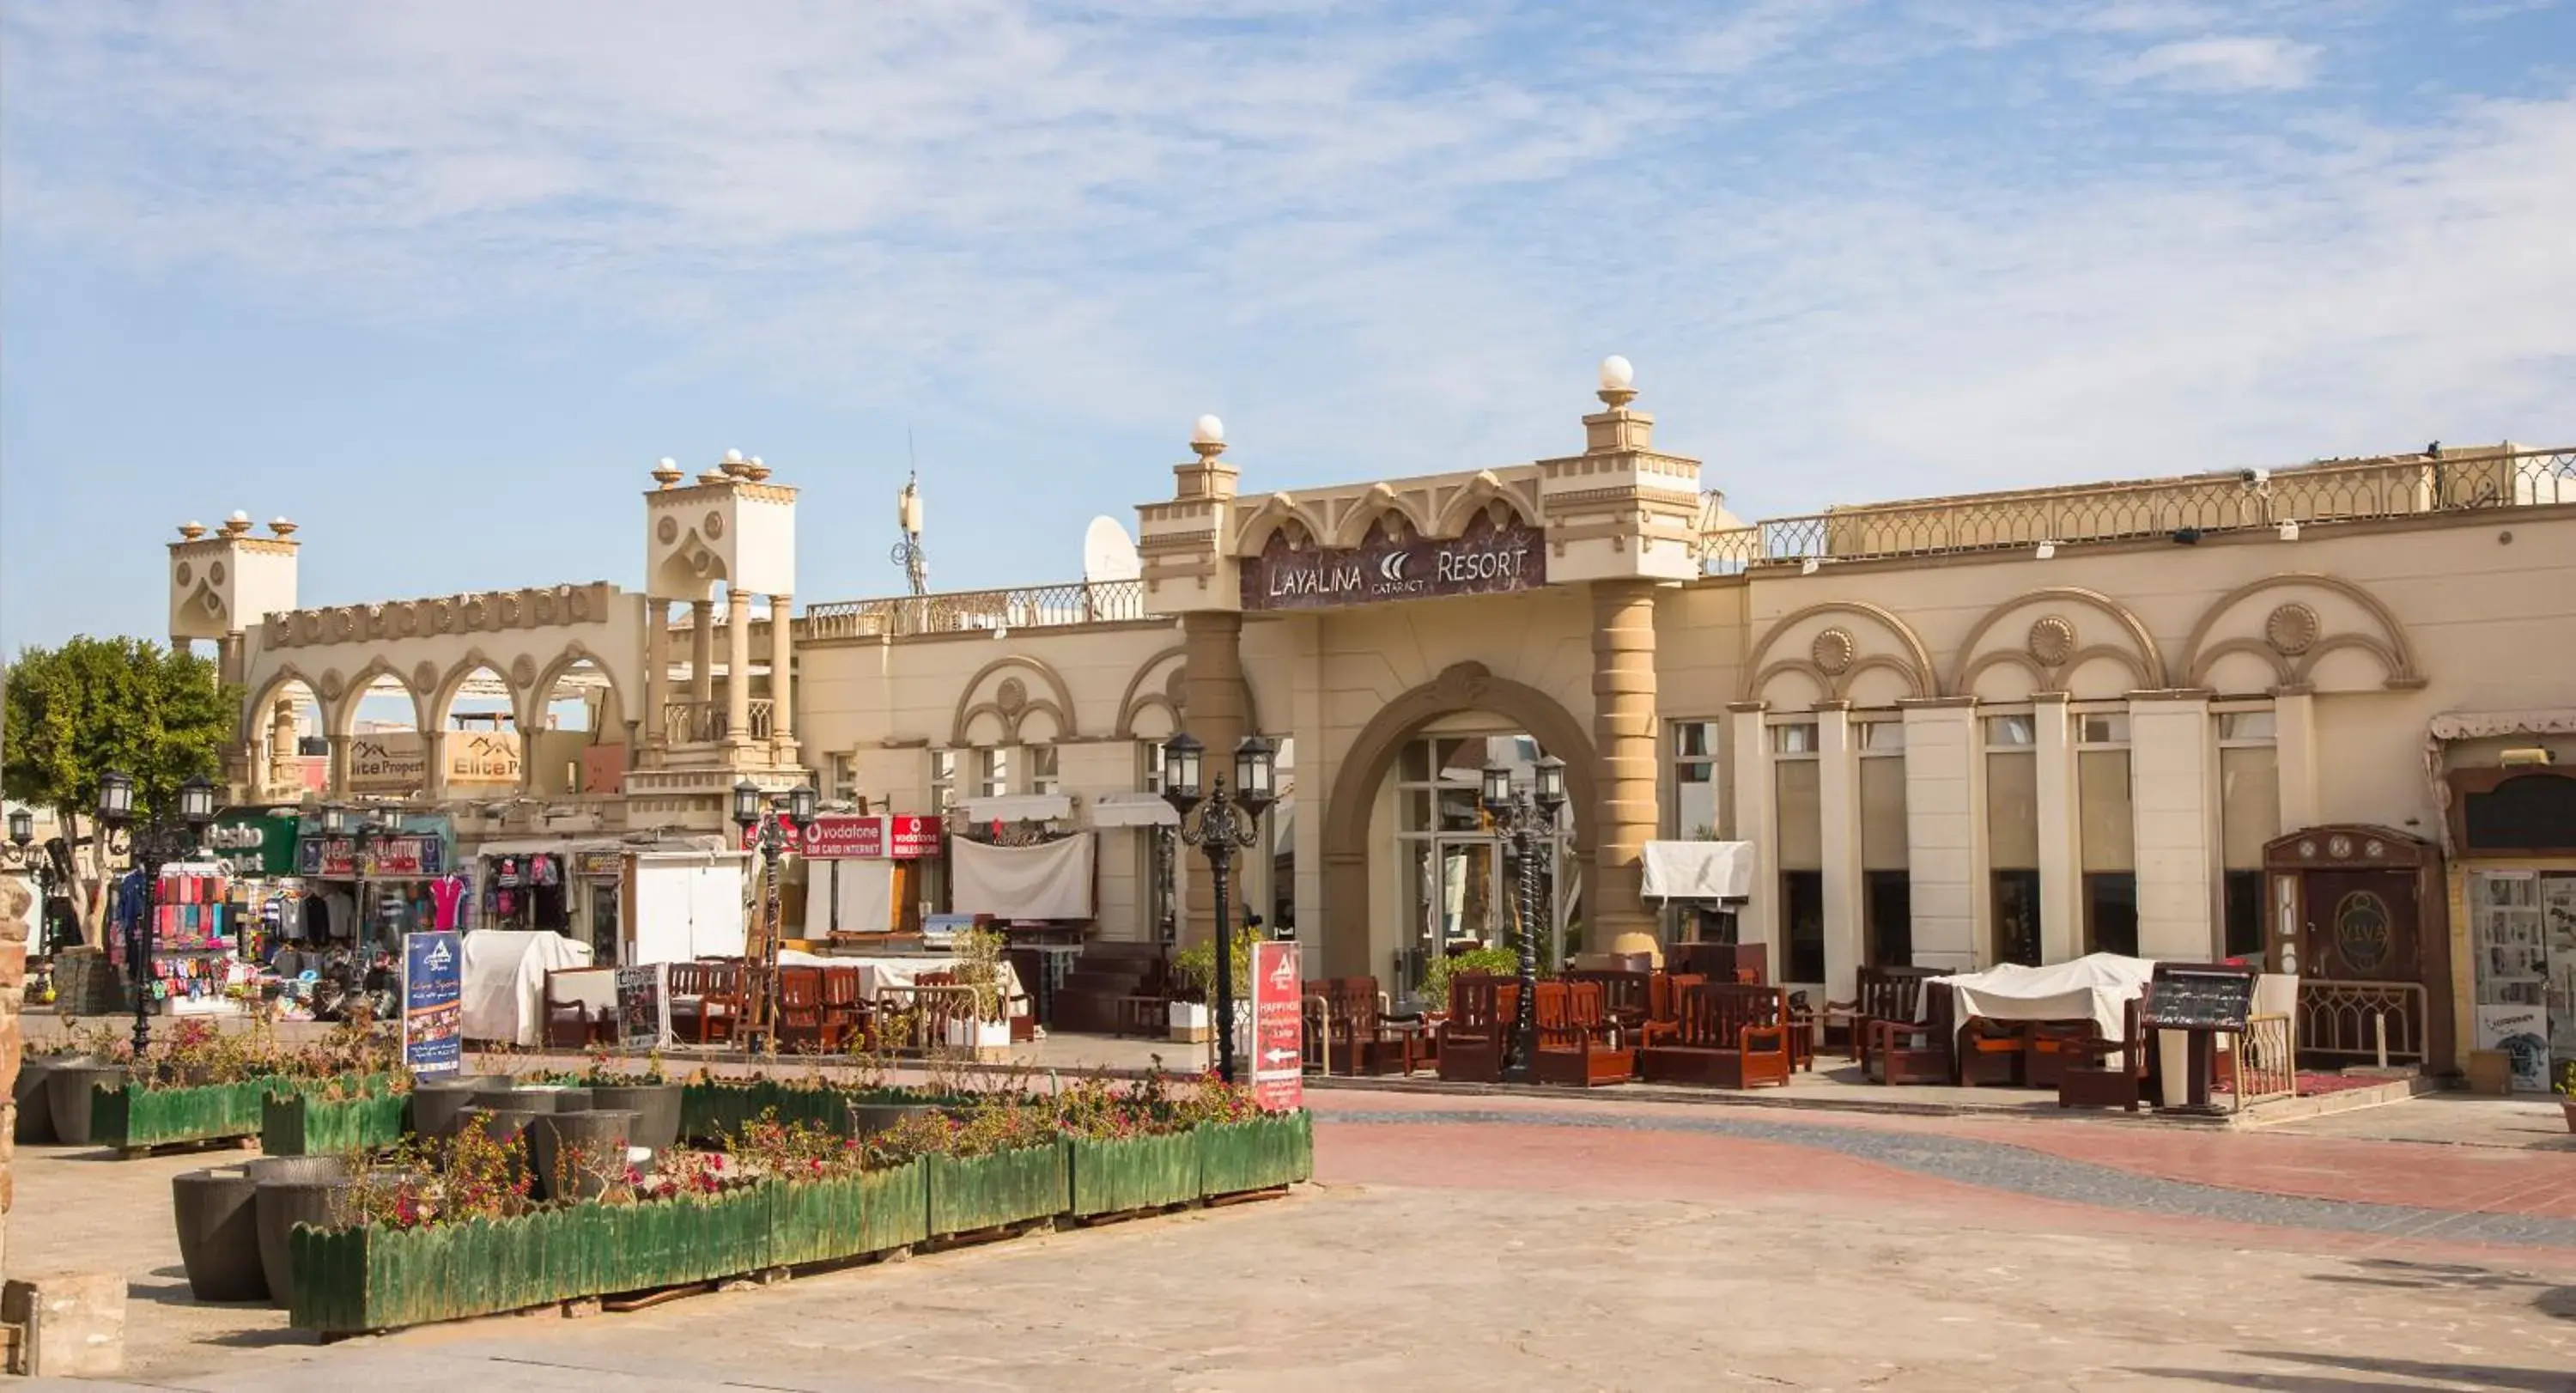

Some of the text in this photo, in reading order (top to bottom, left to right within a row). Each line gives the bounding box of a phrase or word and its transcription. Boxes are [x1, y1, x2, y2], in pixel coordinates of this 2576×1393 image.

[1270, 549, 1527, 596] LAYALINA CATARACT RESORT
[351, 761, 380, 776] lite
[454, 757, 505, 775] Elite
[823, 824, 878, 839] vodafone
